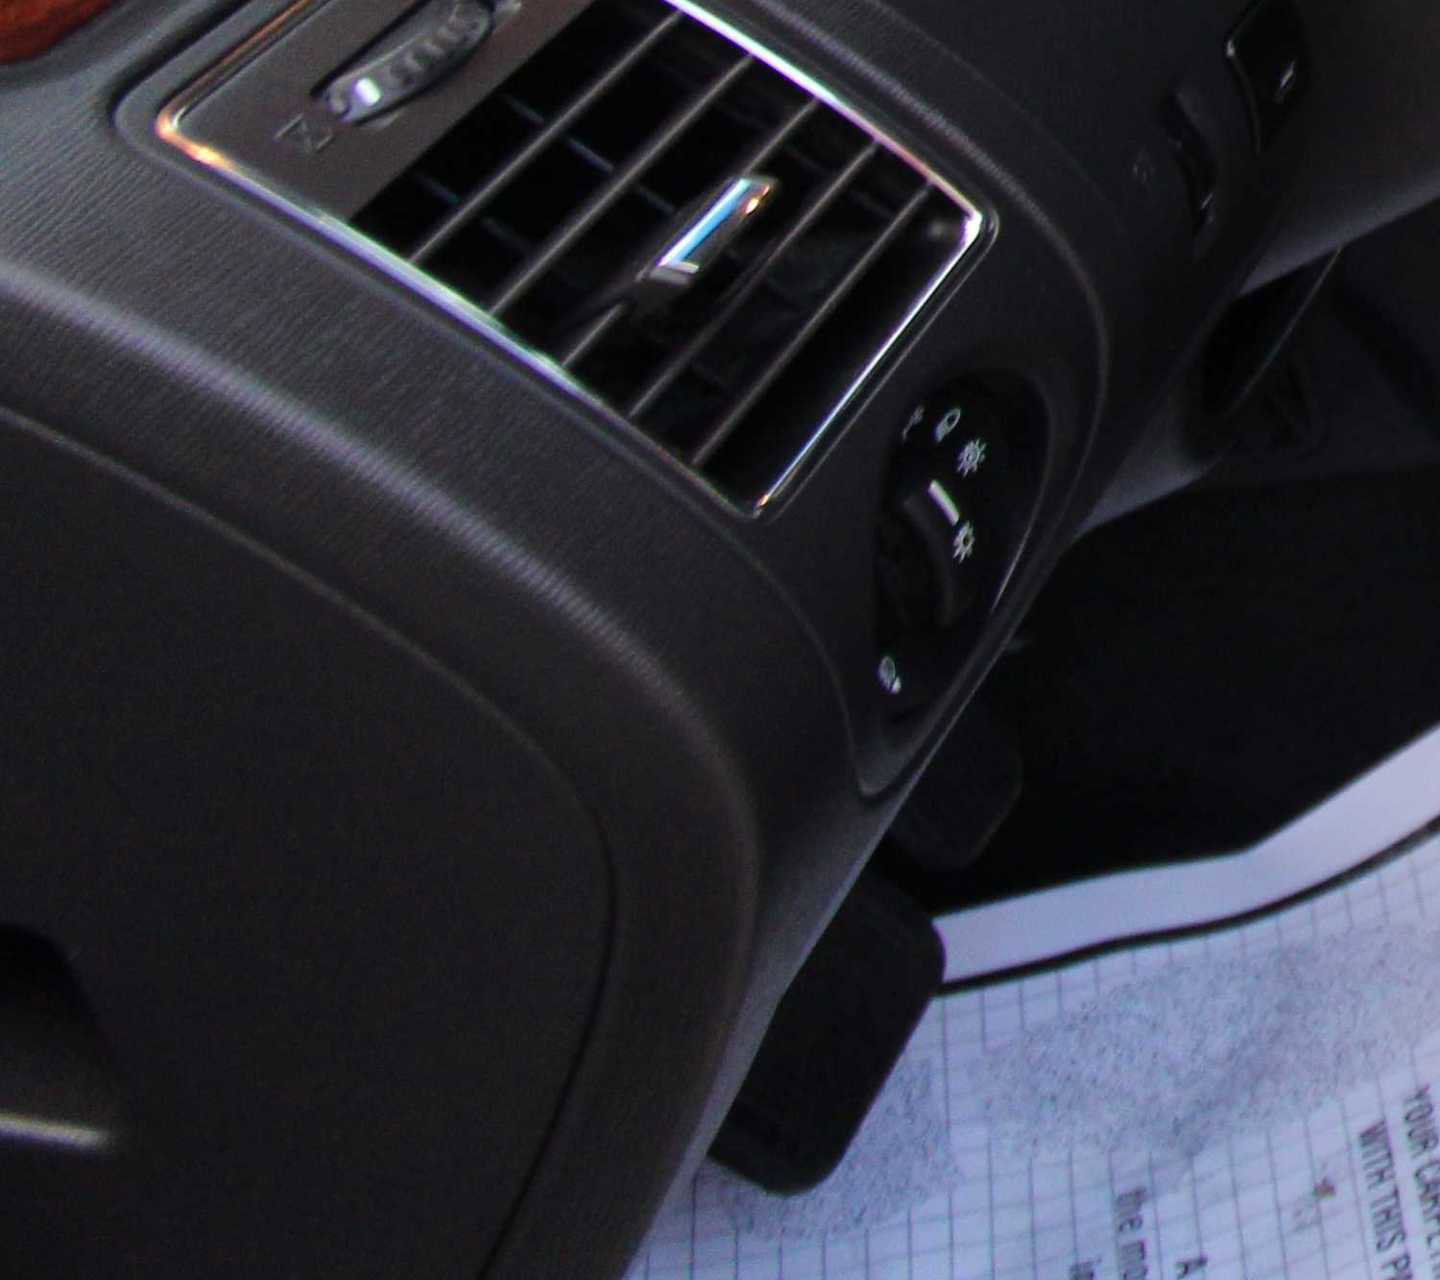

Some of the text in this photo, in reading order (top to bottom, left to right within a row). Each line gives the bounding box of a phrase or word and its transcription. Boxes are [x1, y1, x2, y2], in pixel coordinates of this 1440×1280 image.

[1358, 1119, 1397, 1191] WITH
[1403, 1083, 1440, 1160] YOUR
[1369, 1188, 1408, 1253] THIS
